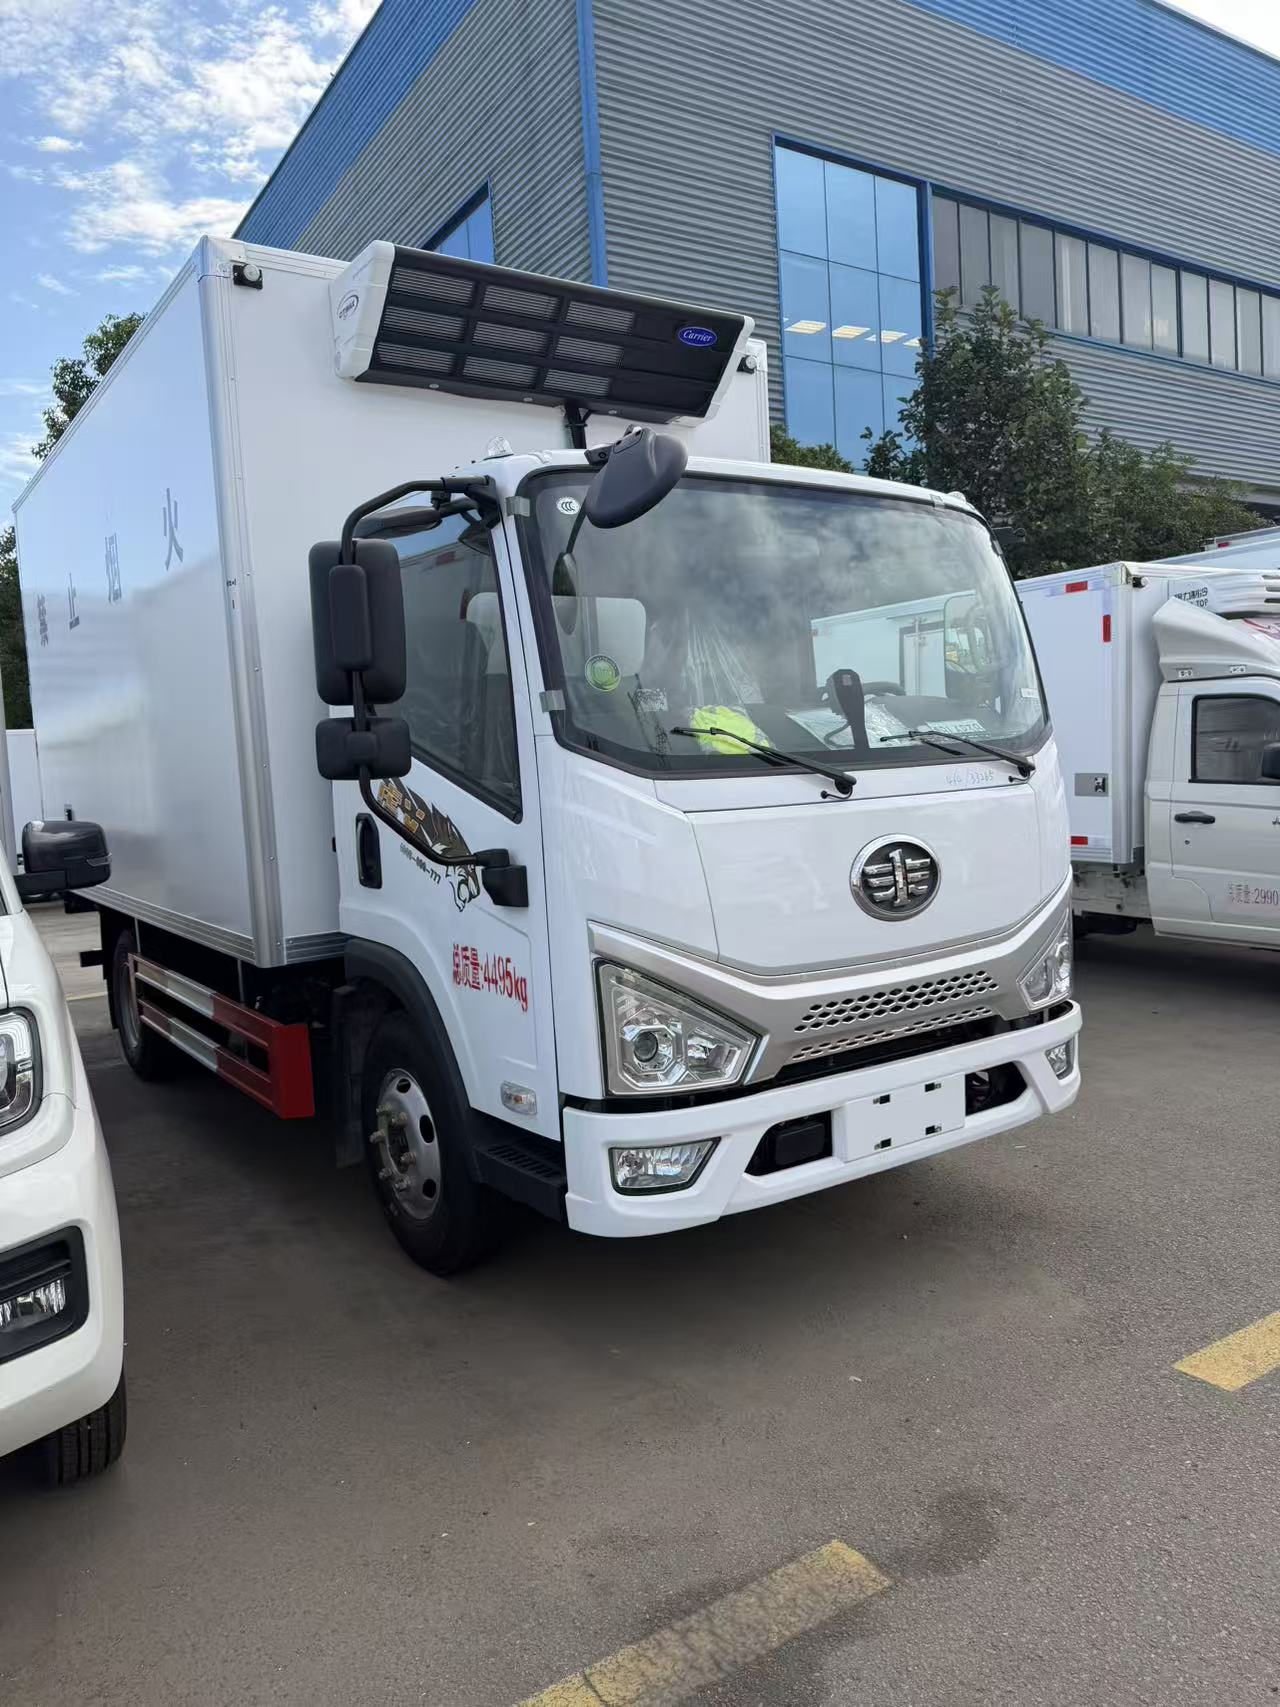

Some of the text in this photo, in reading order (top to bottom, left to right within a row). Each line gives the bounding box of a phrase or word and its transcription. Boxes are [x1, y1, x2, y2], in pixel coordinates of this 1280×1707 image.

[684, 330, 712, 342] Carrier
[453, 942, 528, 1013] 总质量:4495kg
